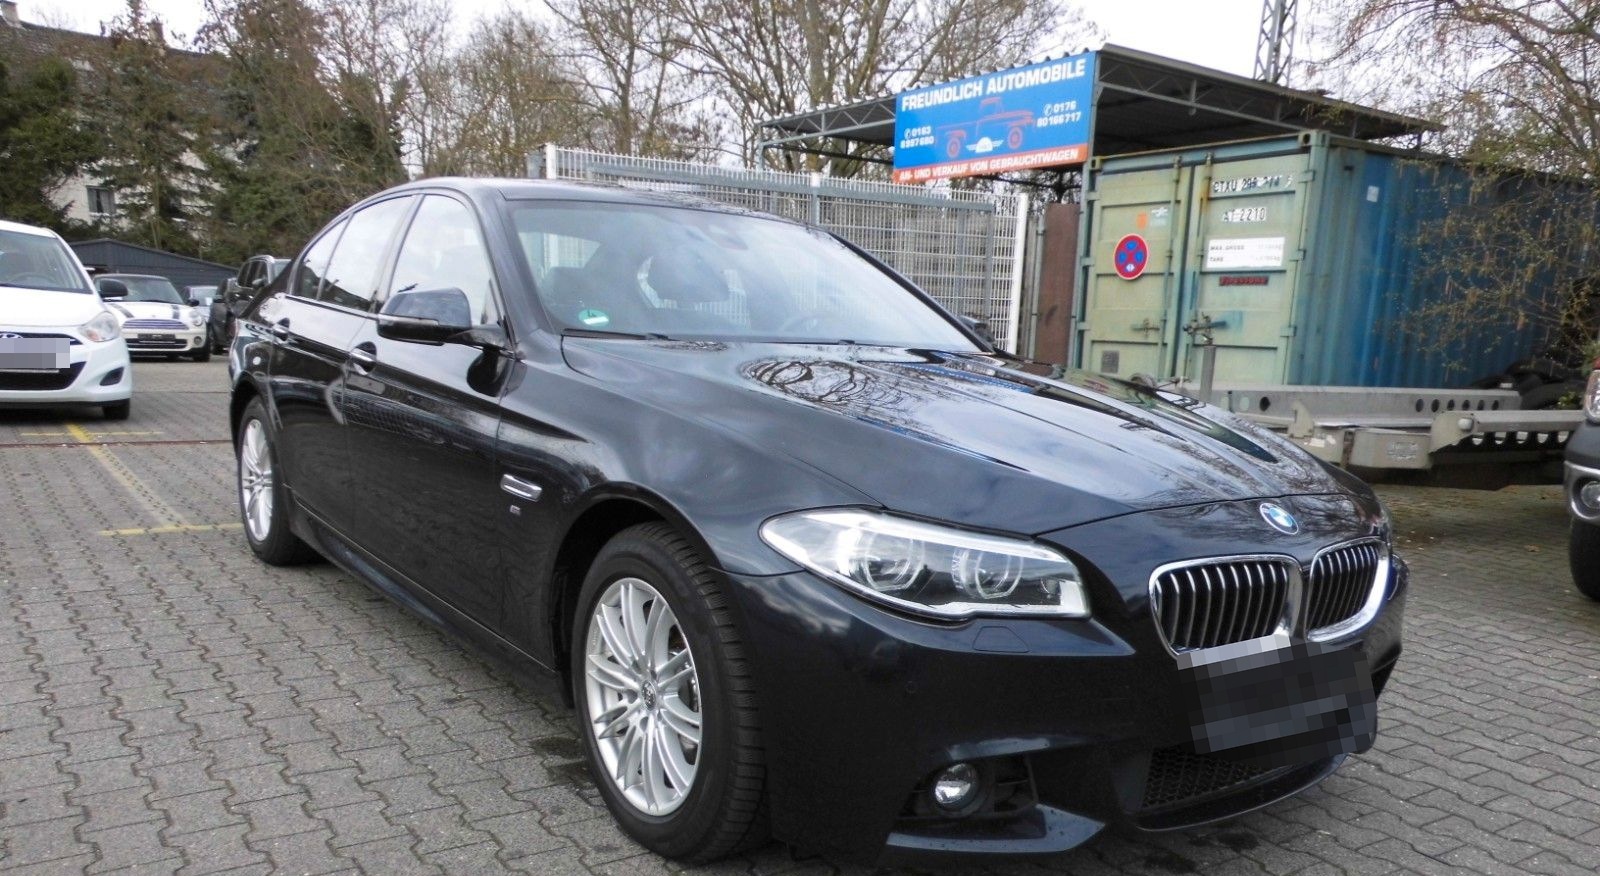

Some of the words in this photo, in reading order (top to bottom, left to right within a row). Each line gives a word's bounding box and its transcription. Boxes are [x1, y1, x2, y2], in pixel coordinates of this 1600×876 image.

[901, 81, 983, 112] FREUNDLICH
[986, 58, 1087, 95] AUTOMOBILE
[899, 169, 914, 181] AN-
[914, 168, 931, 180] UND
[932, 161, 969, 178] VERKAUF
[970, 158, 989, 172] VON
[990, 148, 1080, 170] GEBRAUCHTWAGEN
